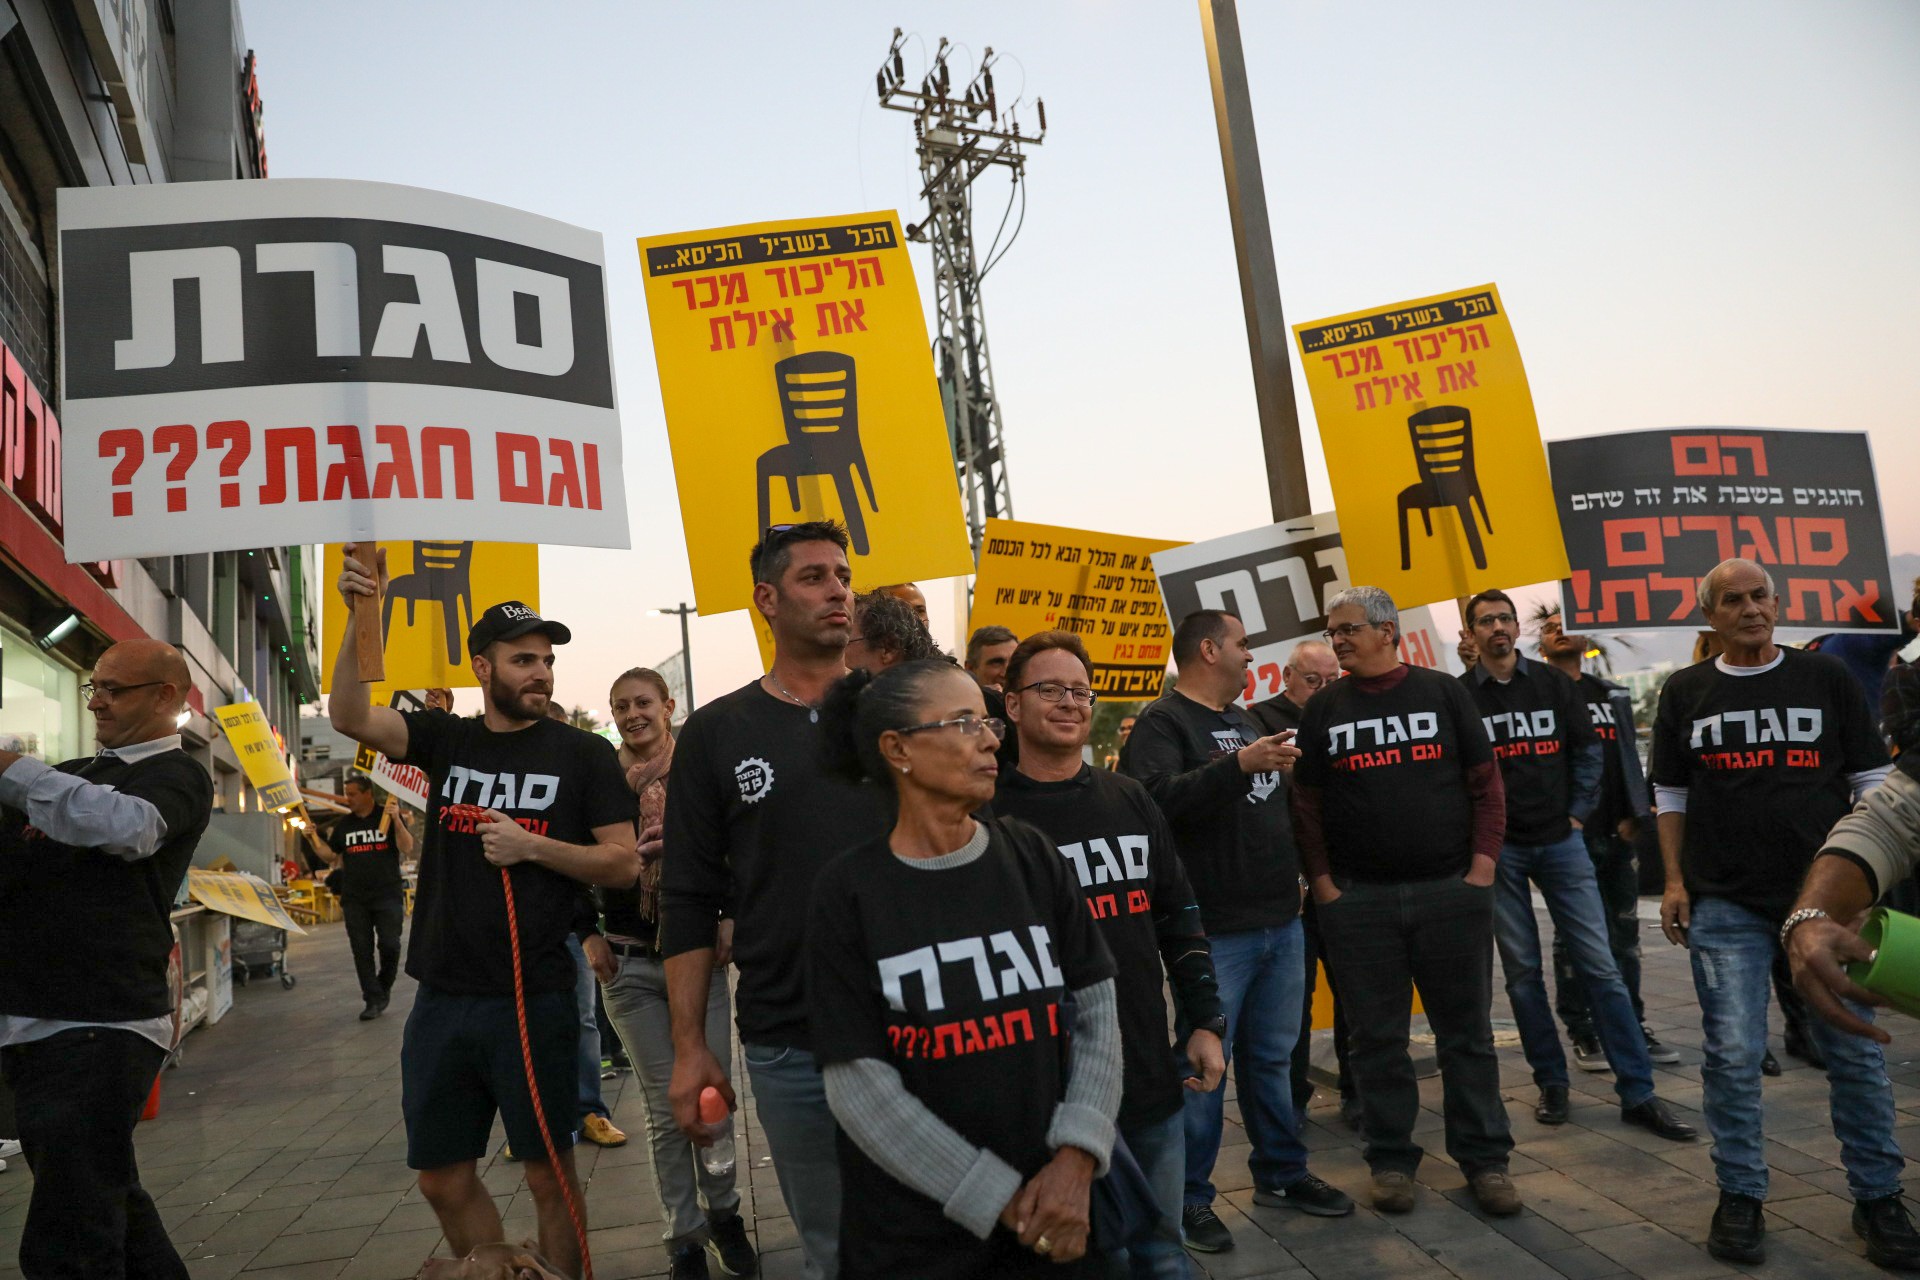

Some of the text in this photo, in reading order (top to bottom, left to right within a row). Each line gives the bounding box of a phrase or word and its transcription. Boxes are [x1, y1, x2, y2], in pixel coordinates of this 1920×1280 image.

[656, 226, 890, 270] הכל בשביל הכיסא...
[671, 256, 885, 310] הליכוד מכר
[115, 242, 575, 377] סגרת
[709, 298, 868, 352] את אילת
[1308, 296, 1491, 348] הכל בשביל הכיסא...
[1322, 323, 1490, 379] הליכוד מכר
[1354, 360, 1480, 411] את אילת
[1670, 435, 1769, 476] הם
[98, 420, 602, 517] וגם חגגת???
[1571, 485, 1864, 511] חוגגים בשבת את זה שהם
[987, 538, 1025, 557] הכנסת
[1030, 540, 1052, 559] לכל
[1603, 515, 1849, 567] סוגרים
[1055, 545, 1082, 563] הבא
[1088, 547, 1117, 568] הכלל
[1120, 552, 1138, 569] את
[1093, 573, 1155, 594] הבדל סיעה.
[1195, 547, 1352, 636] גרת
[995, 587, 1015, 605] ואין
[1018, 589, 1042, 606] איש
[1047, 590, 1062, 608] על
[1067, 593, 1106, 613] היהדות
[1571, 569, 1883, 624] את לת!
[1110, 598, 1127, 616] את
[1130, 600, 1157, 616] כופים
[1101, 619, 1116, 636] על
[1118, 621, 1138, 638] איש
[1142, 622, 1167, 639] כופים
[1113, 643, 1163, 660] מנחם בגין
[1092, 669, 1164, 692] איבדתם
[1328, 711, 1439, 756] סגרת
[1689, 707, 1822, 749] סגרת
[1411, 743, 1442, 761] וגם
[1535, 740, 1560, 755] וגם
[1787, 749, 1820, 768] וגם
[736, 768, 762, 782] קבוצת
[739, 777, 763, 793] בן גל
[441, 765, 560, 811] סגרת
[345, 829, 387, 846] סגרת
[1057, 834, 1150, 888] סגר
[887, 1008, 1035, 1060] חגגת???
